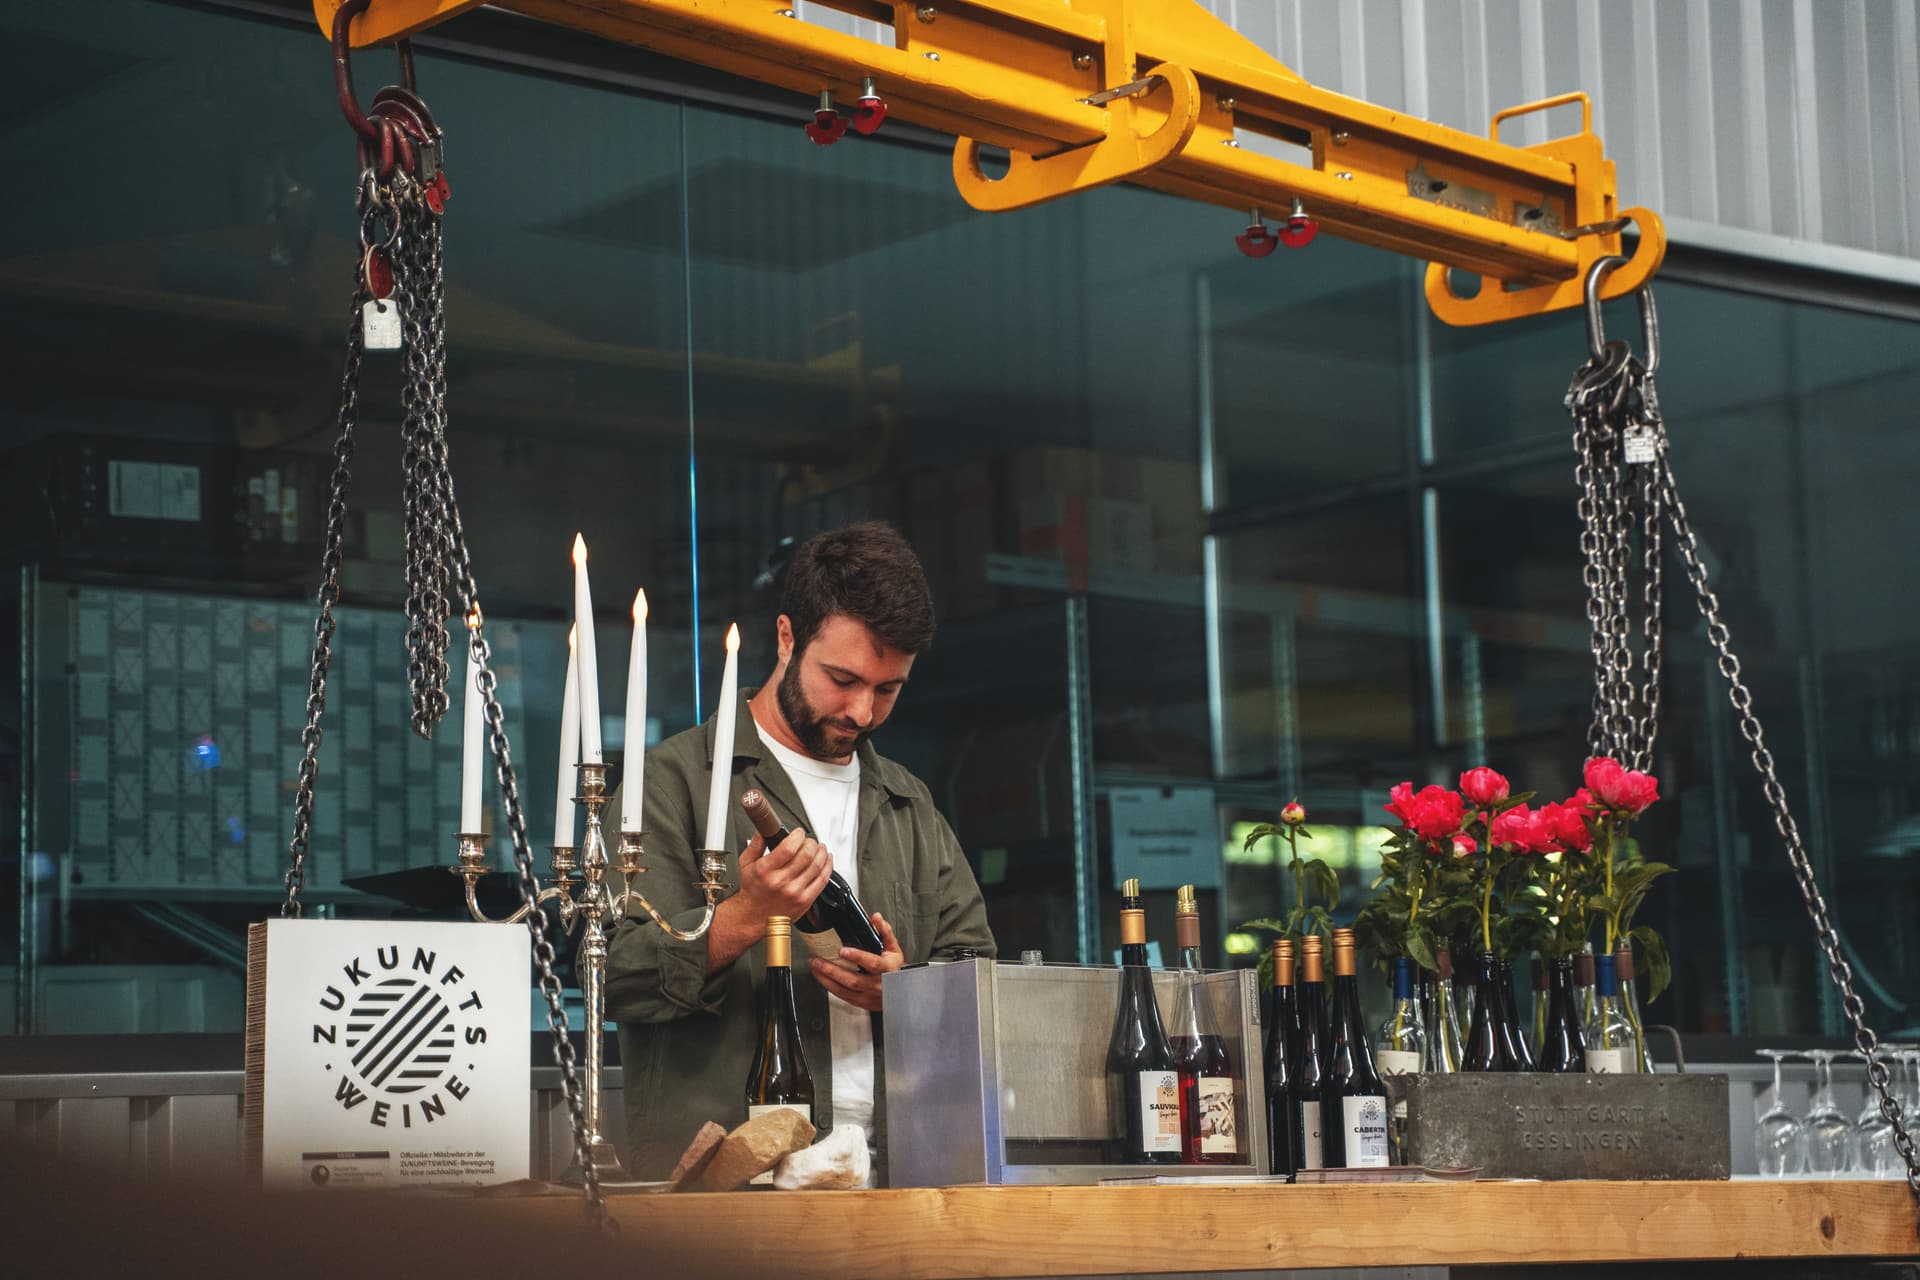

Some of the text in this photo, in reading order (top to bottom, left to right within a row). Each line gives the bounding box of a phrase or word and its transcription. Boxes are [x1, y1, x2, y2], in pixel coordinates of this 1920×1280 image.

[312, 945, 487, 1045] ZUKUNFTS
[334, 1074, 471, 1128] WEINE
[1515, 1104, 1644, 1124] STUTTGART
[1523, 1131, 1641, 1150] ESSLINGEN
